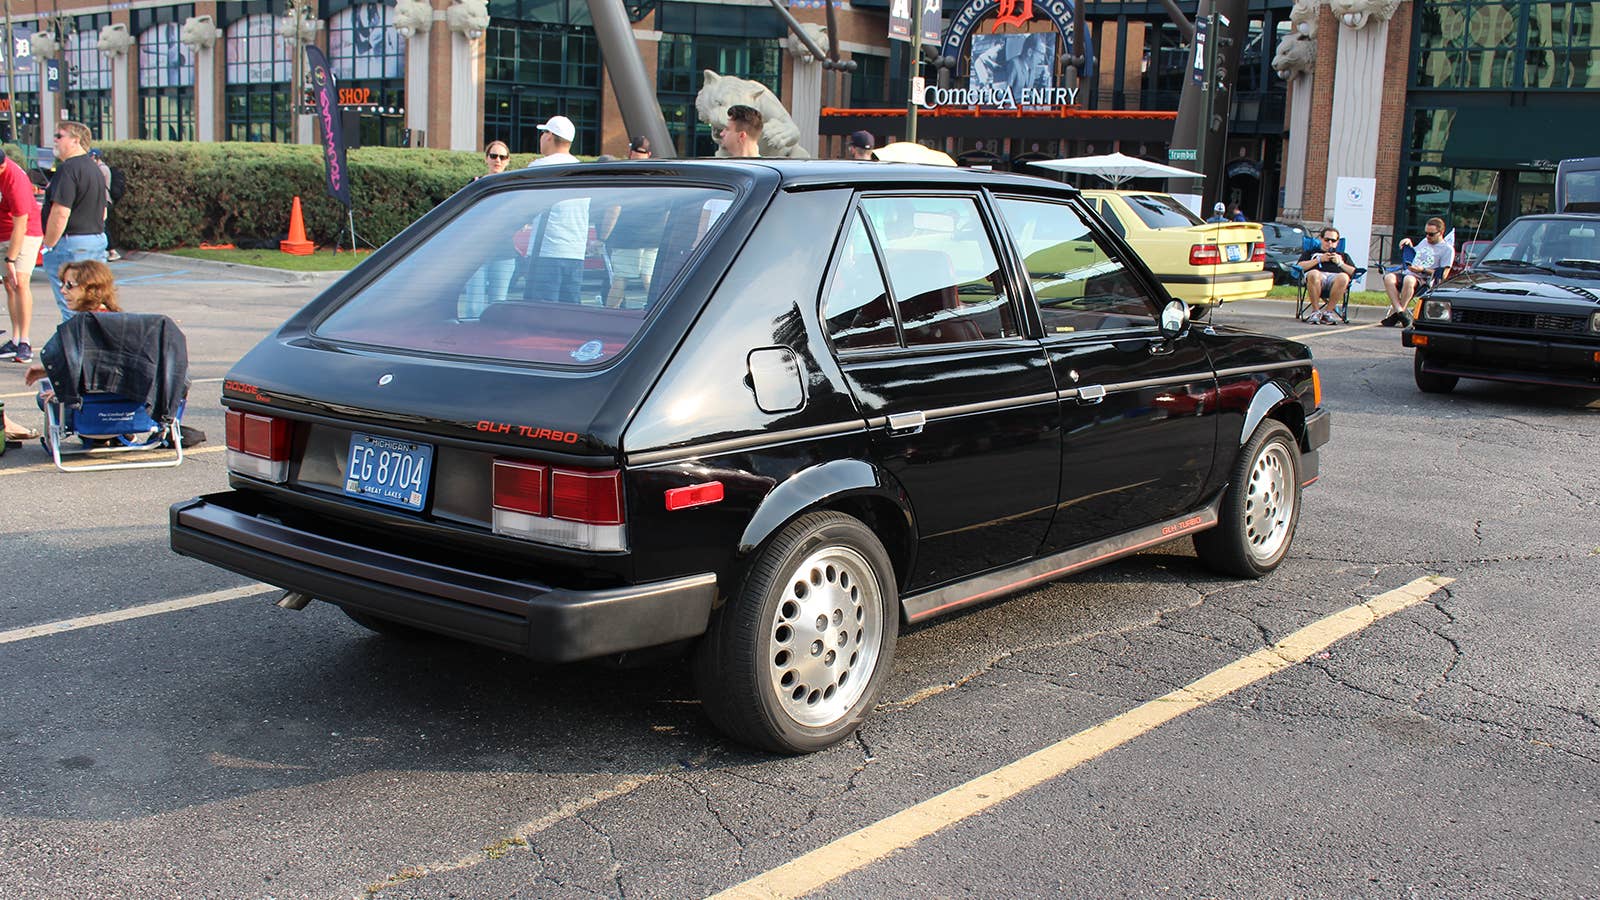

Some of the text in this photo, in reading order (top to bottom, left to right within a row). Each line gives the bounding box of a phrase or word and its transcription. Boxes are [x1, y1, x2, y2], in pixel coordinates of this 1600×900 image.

[948, 0, 990, 47] DETRO
[338, 87, 371, 104] SHOP
[1020, 87, 1079, 105] ENTRY
[225, 381, 258, 395] DODGE
[477, 420, 578, 444] GLH TURBO
[371, 439, 409, 452] MICHIGAN
[349, 445, 424, 492] EG 8704
[364, 485, 382, 495] GREAT
[384, 490, 402, 499] LAKES
[1162, 516, 1202, 535] GLH TURBO
